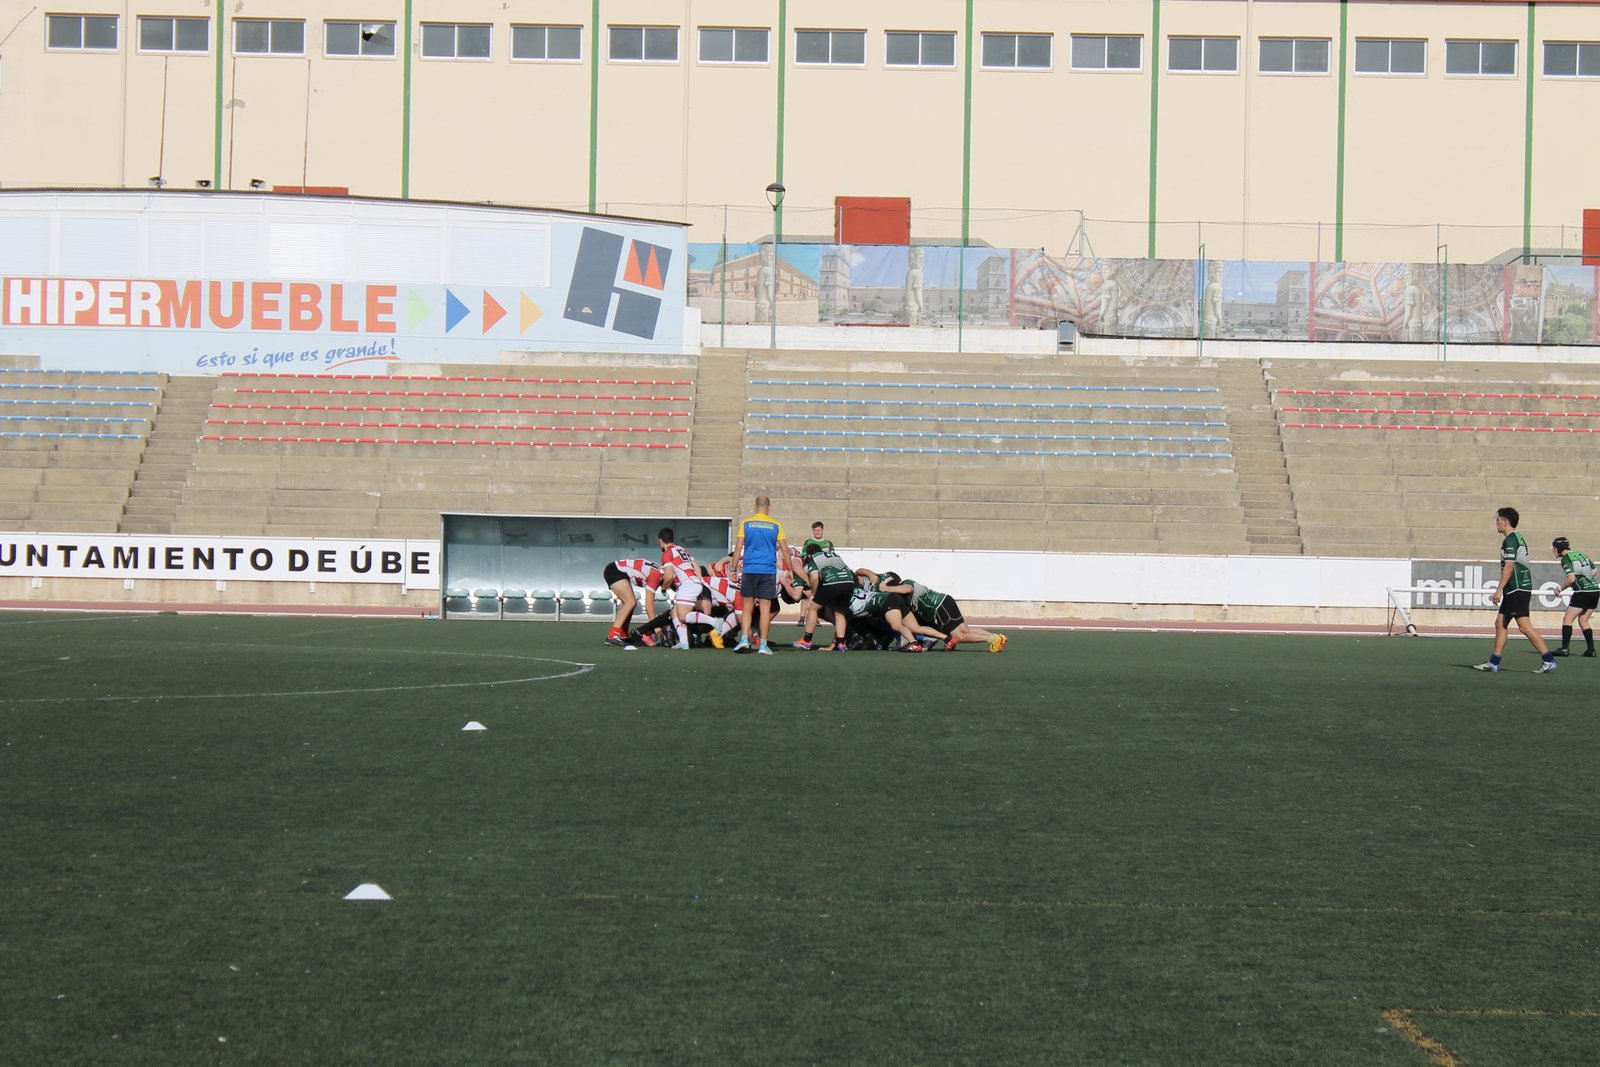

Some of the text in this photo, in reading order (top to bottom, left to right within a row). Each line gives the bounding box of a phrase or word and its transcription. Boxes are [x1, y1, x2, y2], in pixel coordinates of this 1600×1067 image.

[7, 278, 397, 333] HIPERMUEBLE
[196, 350, 236, 368] Esto
[262, 349, 294, 369] que
[300, 349, 319, 362] es
[325, 337, 396, 364] grande!
[0, 543, 431, 574] UNTAMIENTO DE ÚBE
[1416, 565, 1502, 607] milla
